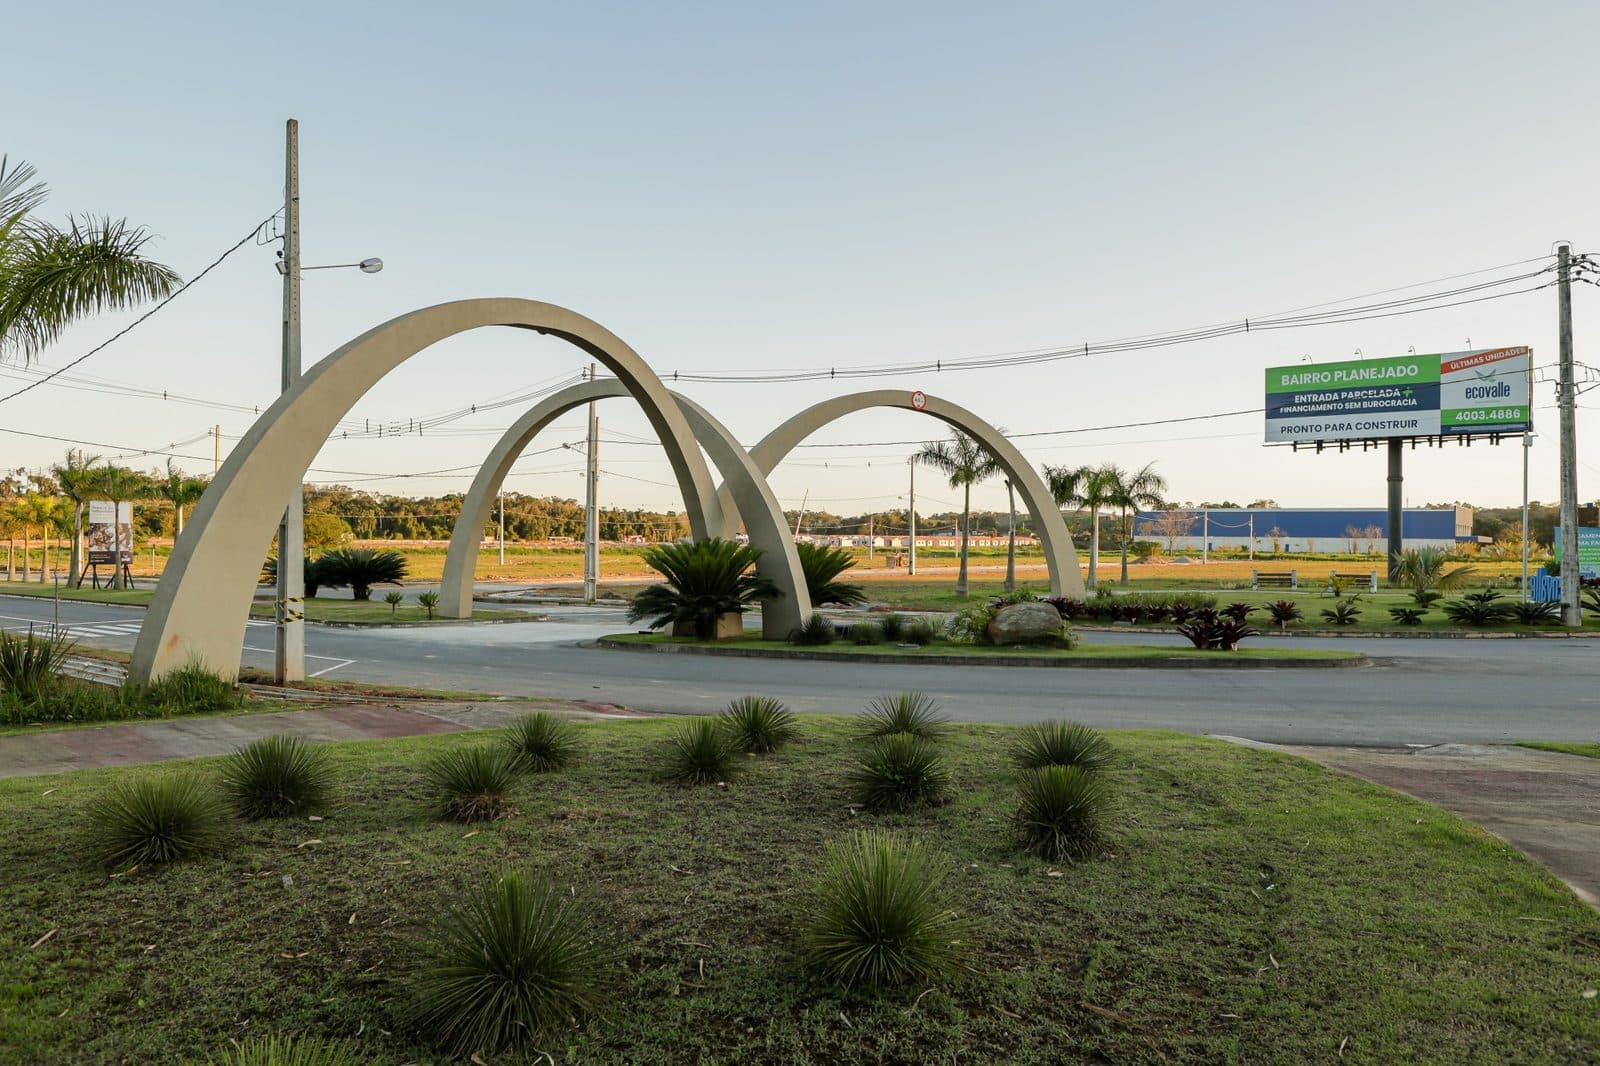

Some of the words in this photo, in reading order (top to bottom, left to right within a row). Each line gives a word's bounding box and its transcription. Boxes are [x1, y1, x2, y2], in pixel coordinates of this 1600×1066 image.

[1450, 356, 1484, 370] ÚLTIMAS
[1281, 372, 1332, 386] BAIRRO
[1334, 365, 1419, 381] PLANEJADO
[1294, 392, 1339, 403] ENTRADA
[1341, 388, 1401, 399] PARCELADA
[1466, 382, 1510, 399] ecovalle
[1280, 402, 1344, 413] FINANCIAMENTO
[1344, 401, 1362, 410] SEM
[1362, 398, 1418, 409] BUROCRACIA
[1456, 409, 1520, 420] 4003.4886
[1281, 424, 1322, 434] PRONTO
[1324, 422, 1353, 433] PARA
[1354, 419, 1418, 432] CONSTRUIR
